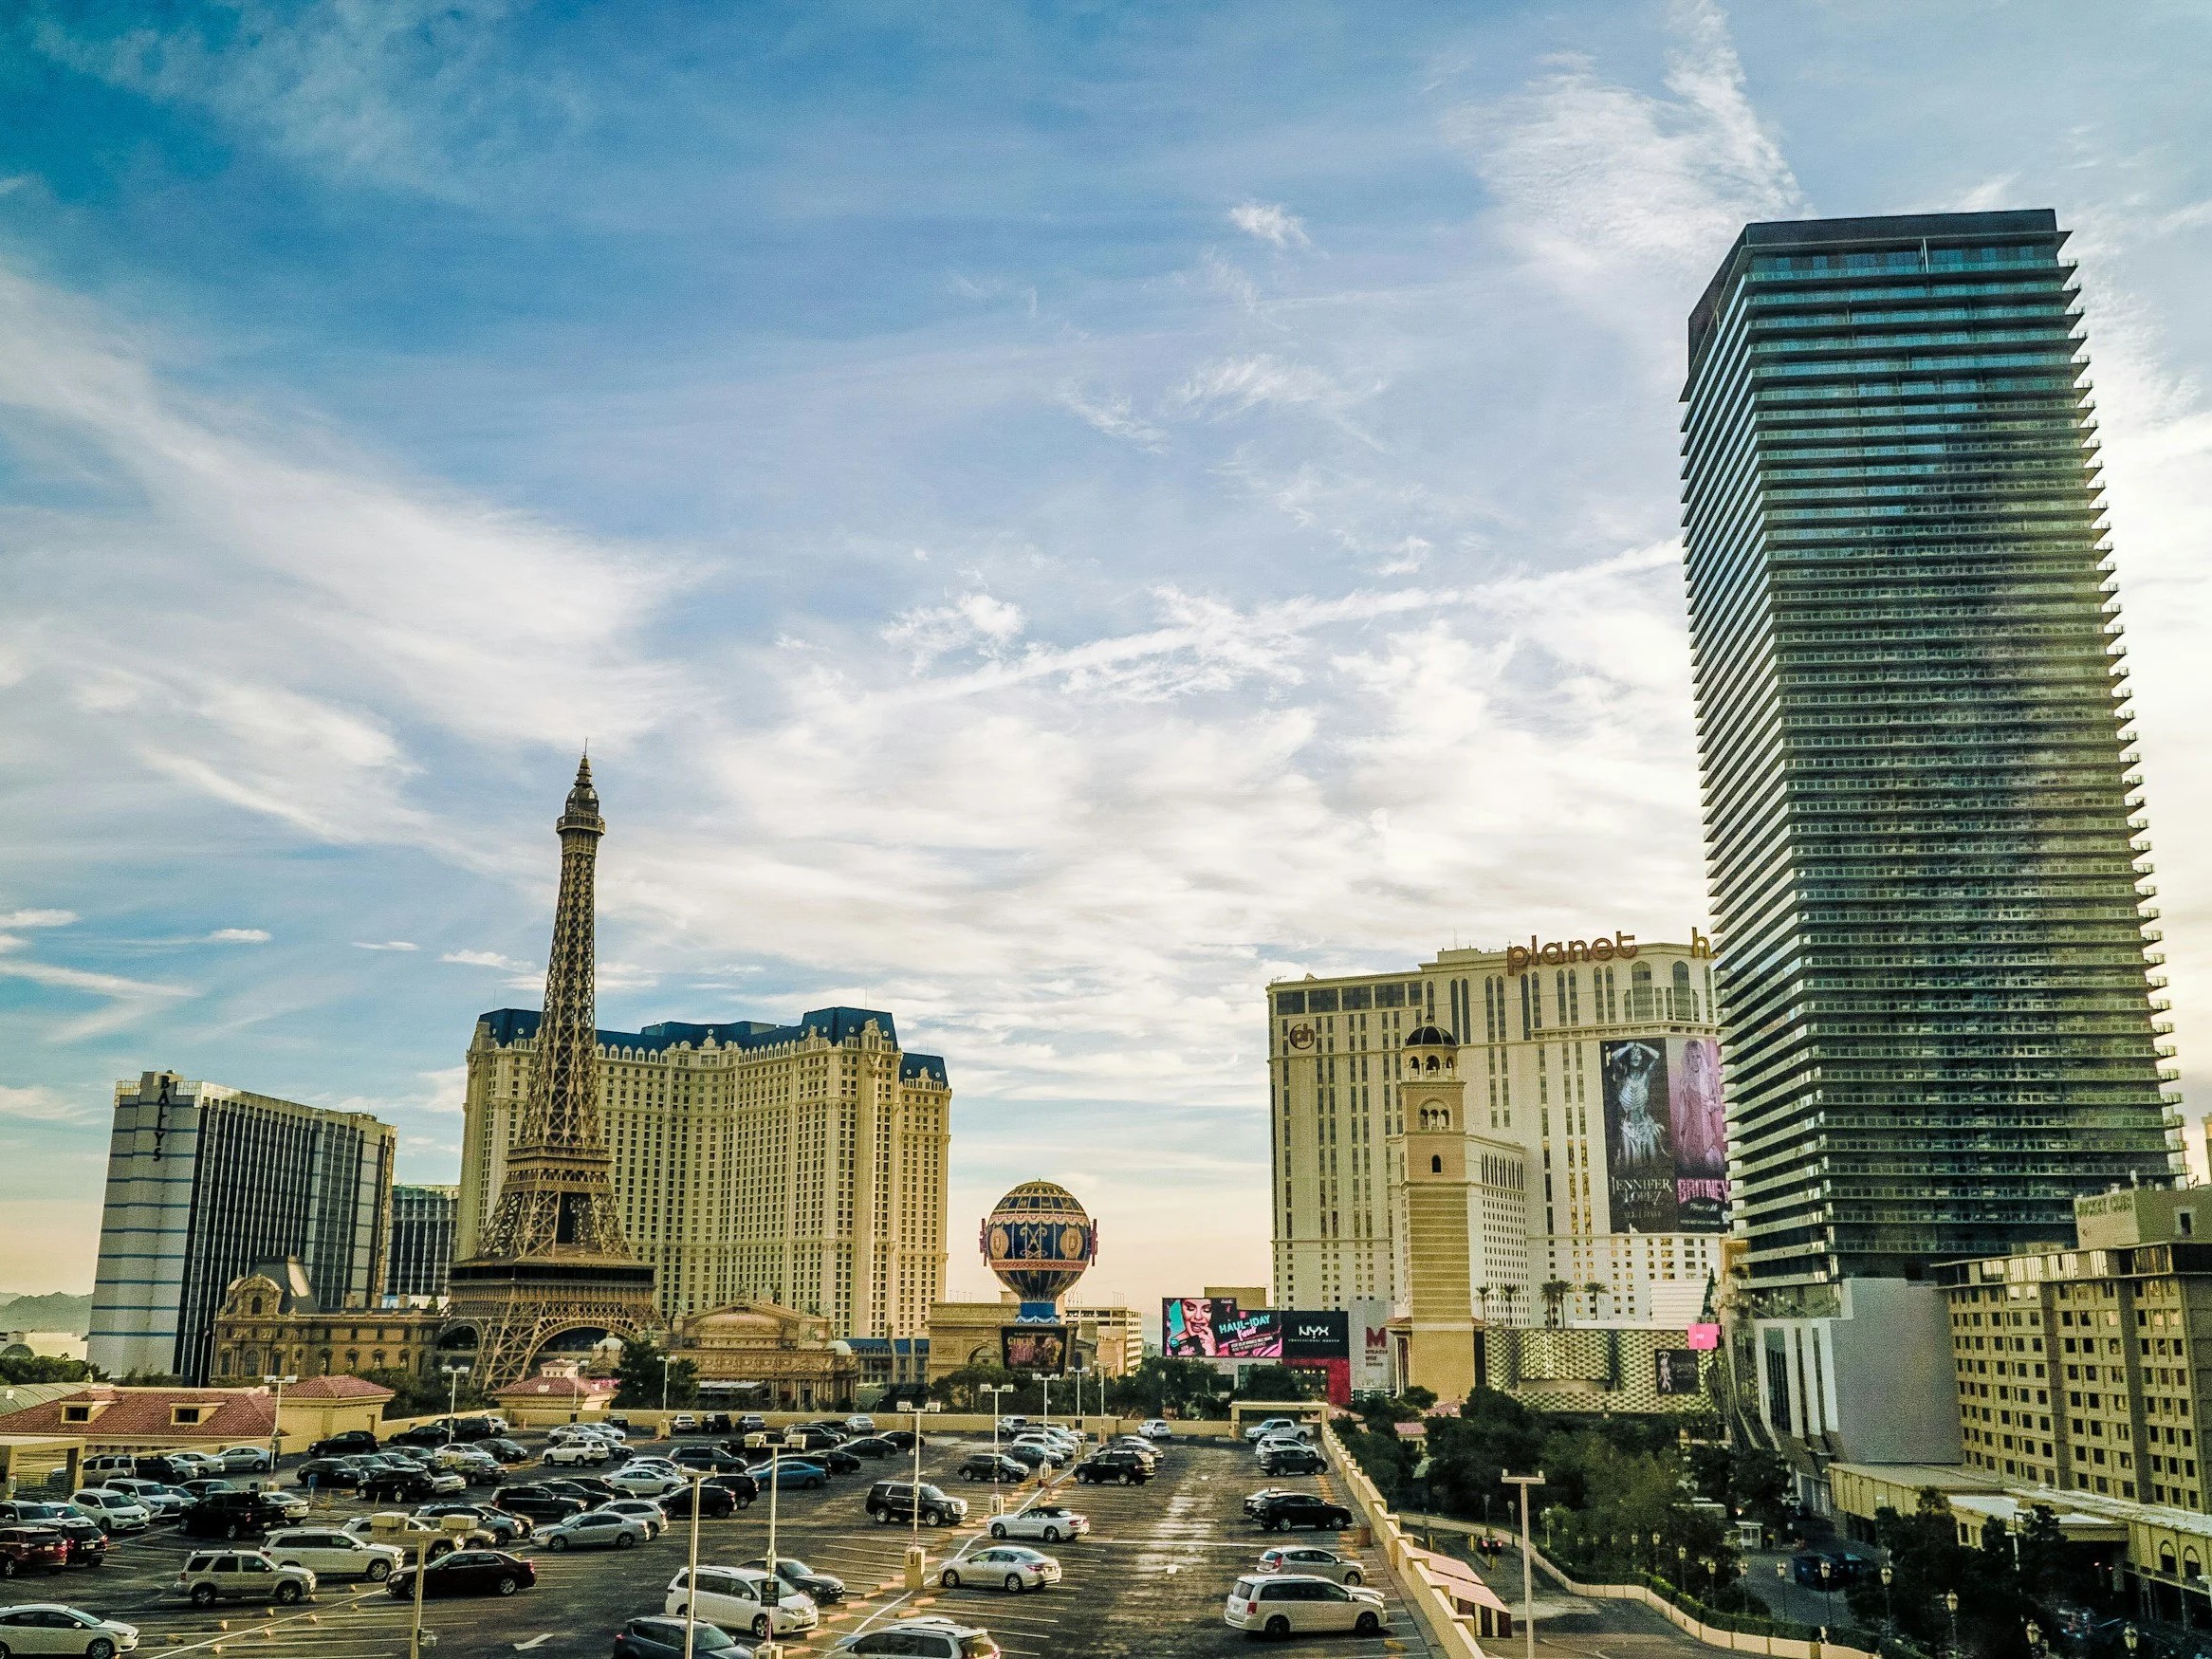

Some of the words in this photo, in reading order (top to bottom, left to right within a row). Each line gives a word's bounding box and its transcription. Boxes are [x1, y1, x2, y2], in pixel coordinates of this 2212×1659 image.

[1506, 931, 1638, 976] planet
[1612, 1176, 1673, 1195] JENNIFER
[1678, 1178, 1729, 1204] BRITNEY
[1218, 1314, 1271, 1335] HAUL-IDAY
[1299, 1325, 1329, 1338] NYX
[1366, 1326, 1387, 1348] M
